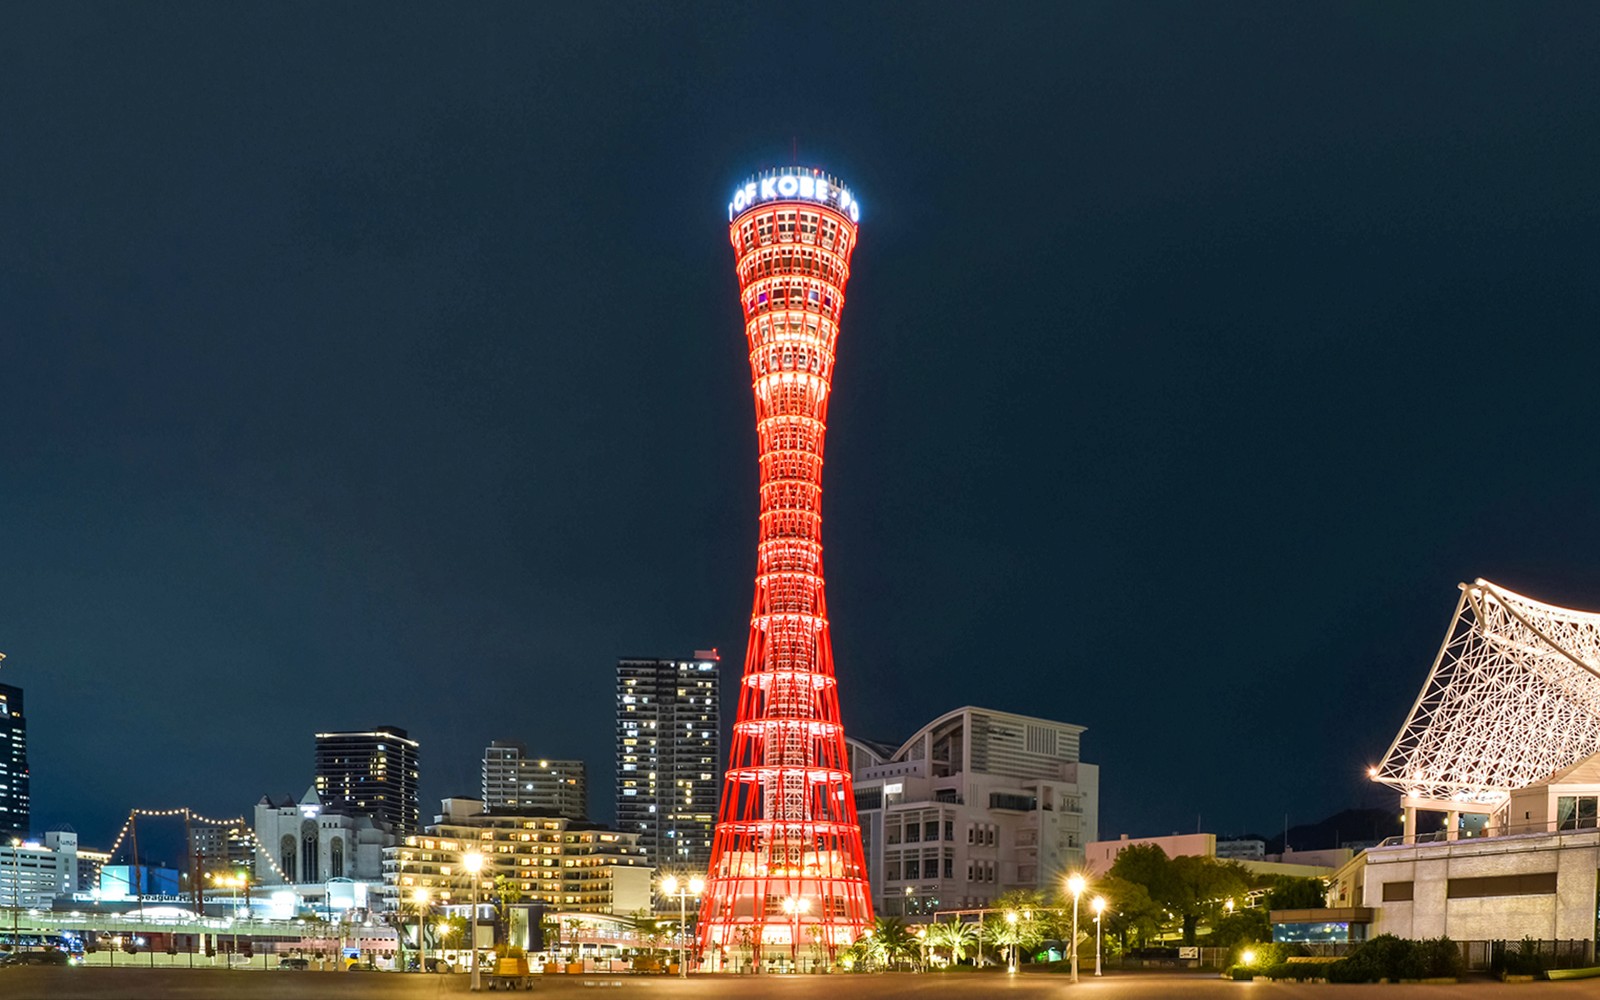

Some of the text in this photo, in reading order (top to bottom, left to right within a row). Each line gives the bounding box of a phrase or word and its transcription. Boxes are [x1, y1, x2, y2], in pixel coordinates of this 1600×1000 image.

[734, 182, 757, 212] OF
[761, 176, 829, 200] KOBE
[179, 893, 214, 902] Haor
